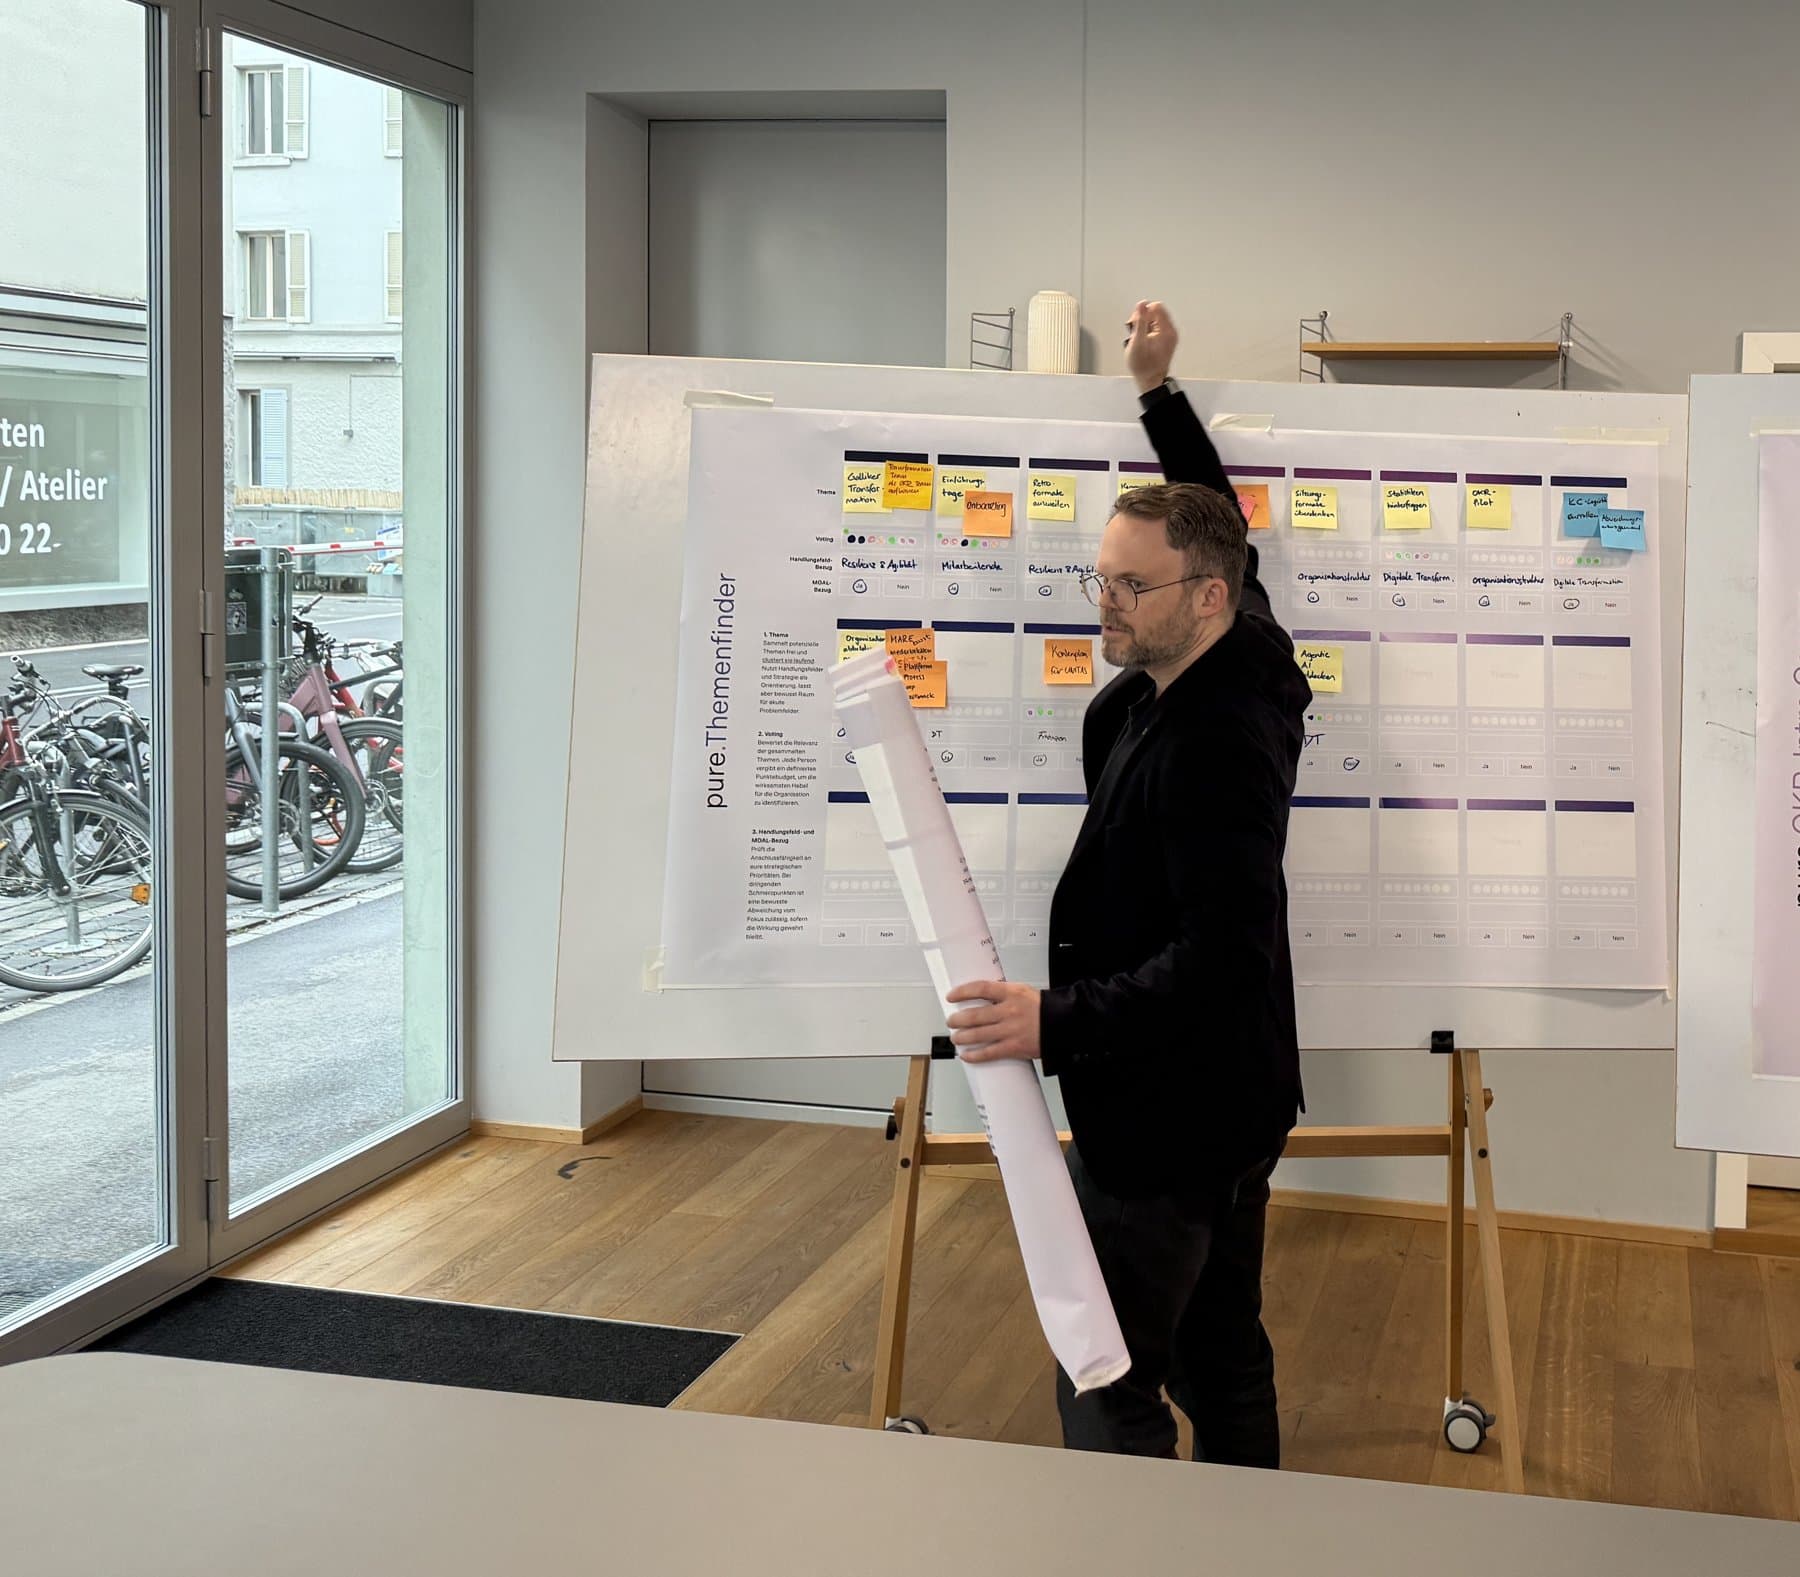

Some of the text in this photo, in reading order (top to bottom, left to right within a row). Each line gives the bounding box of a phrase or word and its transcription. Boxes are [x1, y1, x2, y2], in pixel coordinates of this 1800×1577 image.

[20, 468, 107, 500] Atelier
[942, 489, 964, 502] tage
[1033, 489, 1064, 497] formate
[942, 560, 1003, 572] Mitarbeitende
[1383, 572, 1414, 586] Digitale
[1300, 650, 1331, 661] Agentic
[705, 572, 737, 808] pure.Themenfinder
